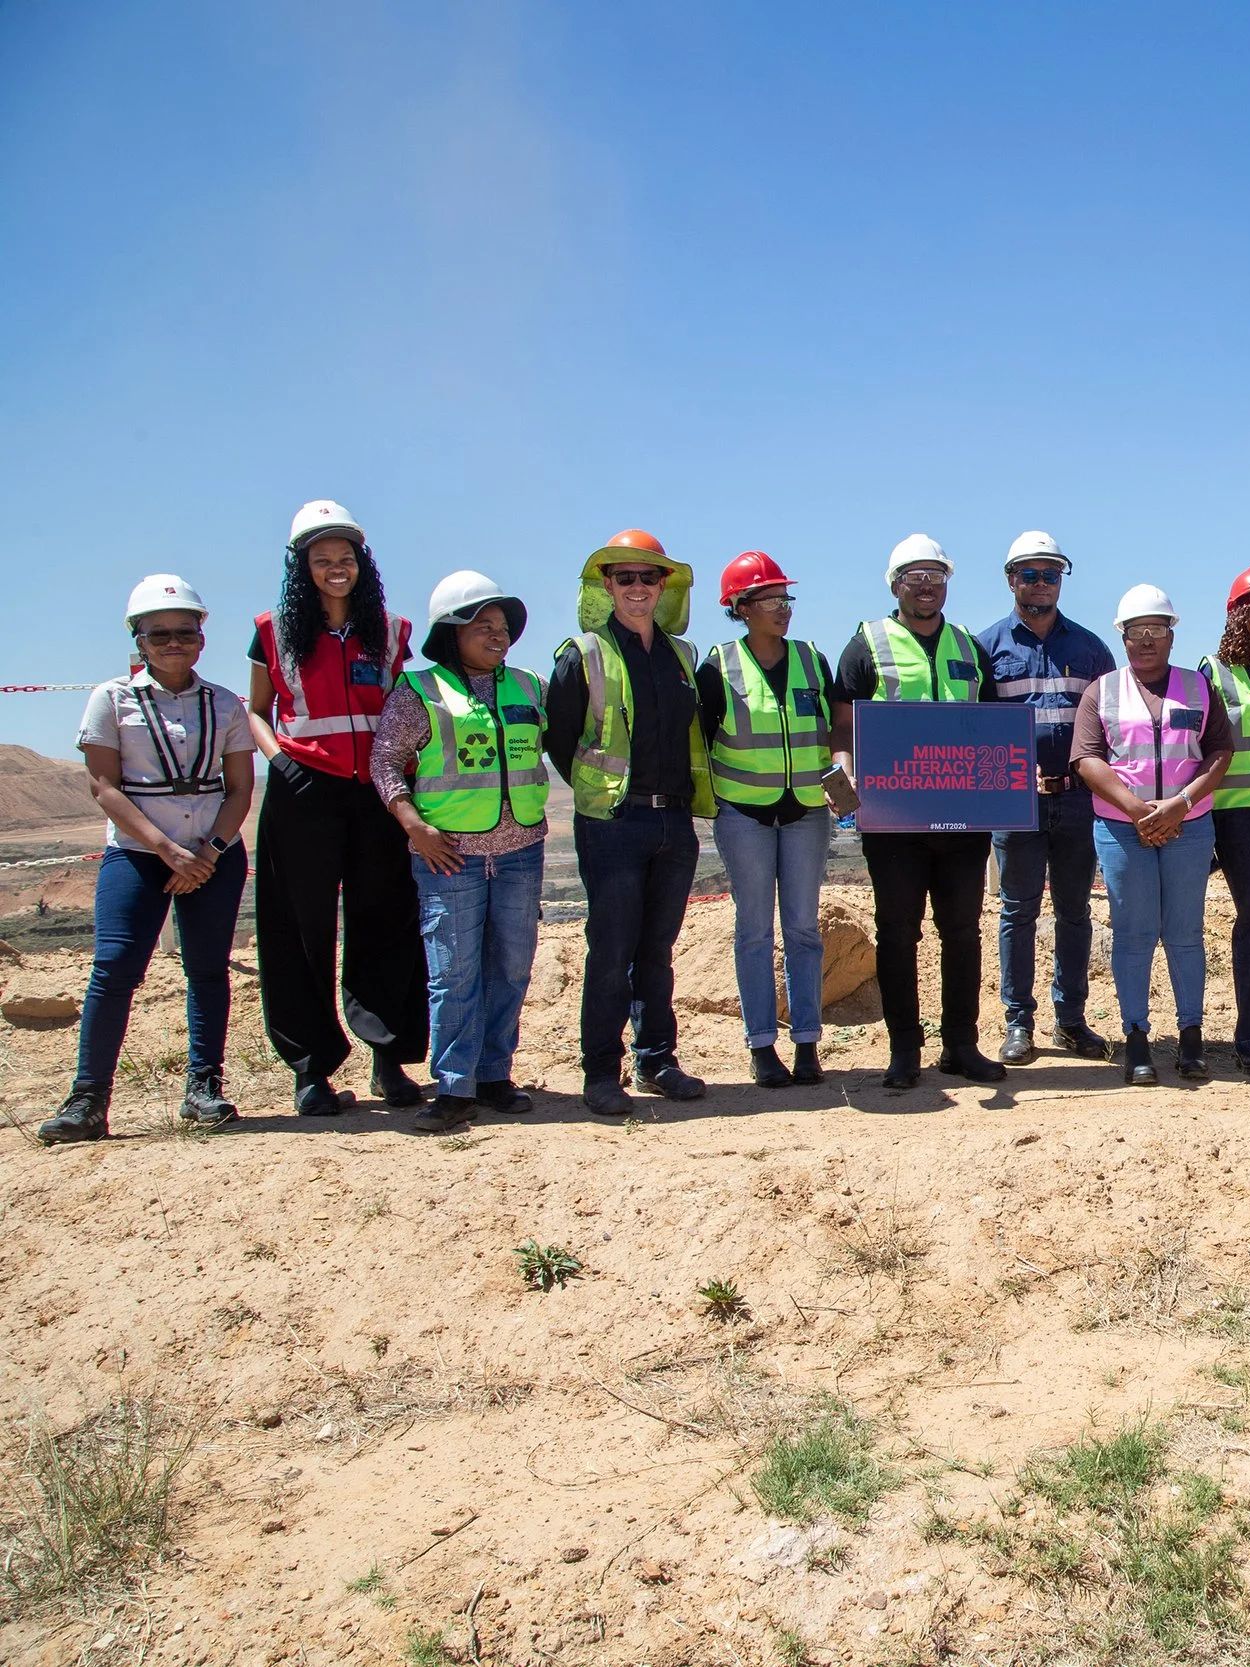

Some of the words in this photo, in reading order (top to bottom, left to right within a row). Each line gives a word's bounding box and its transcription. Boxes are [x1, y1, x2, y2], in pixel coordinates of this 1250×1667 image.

[509, 745, 537, 753] Recycling
[913, 745, 976, 760] MINING
[977, 745, 1008, 768] 20
[894, 760, 975, 775] LITERACY
[1009, 743, 1028, 791] MJT
[864, 775, 977, 790] PROGRAMME
[977, 768, 1009, 791] 26
[930, 822, 967, 830] #MJT2026
